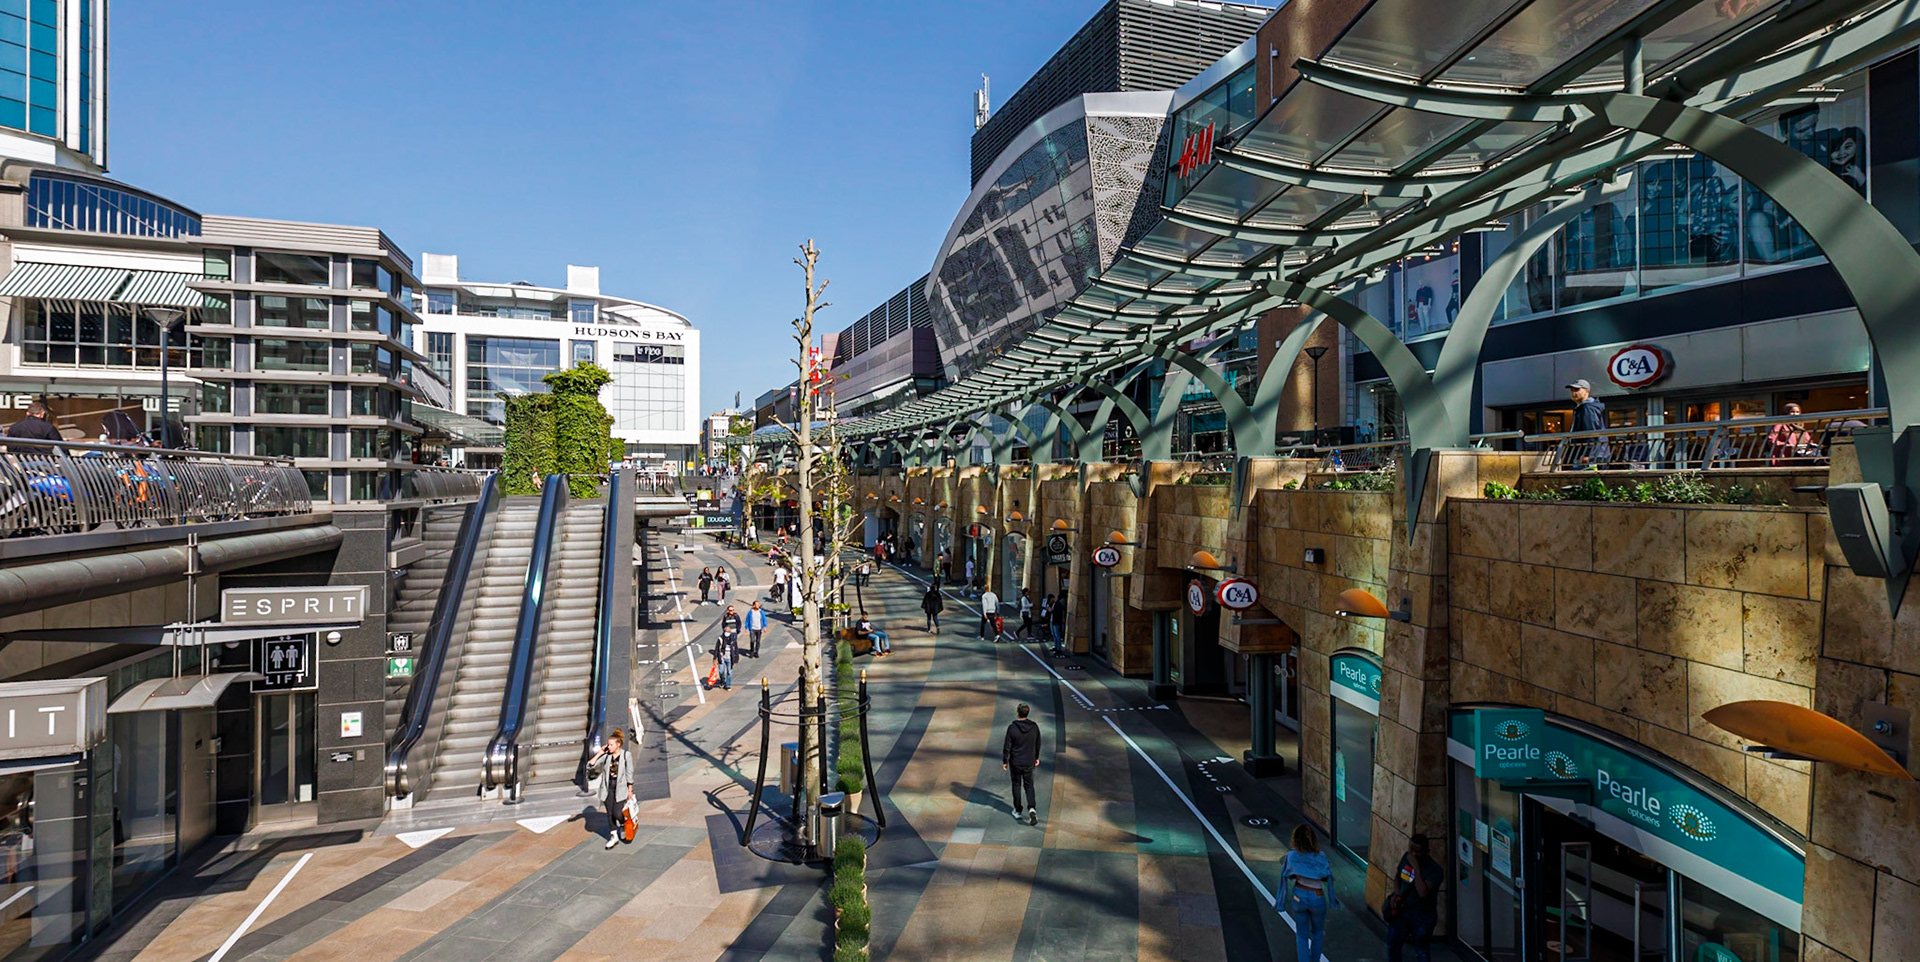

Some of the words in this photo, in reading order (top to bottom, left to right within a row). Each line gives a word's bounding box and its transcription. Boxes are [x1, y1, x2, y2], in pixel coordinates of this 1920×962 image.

[1177, 122, 1215, 179] H&M
[574, 326, 651, 339] HUDSON'S
[655, 331, 684, 341] BAY
[1616, 355, 1654, 377] C&A
[1098, 552, 1117, 562] C&A
[1226, 587, 1253, 603] C&A
[232, 597, 356, 615] ESPRIT
[265, 673, 305, 685] LIFT
[1340, 661, 1367, 685] Pearle
[1485, 743, 1540, 760] Pearle
[1597, 768, 1661, 816] Pearle
[1627, 806, 1661, 828] opticiens
